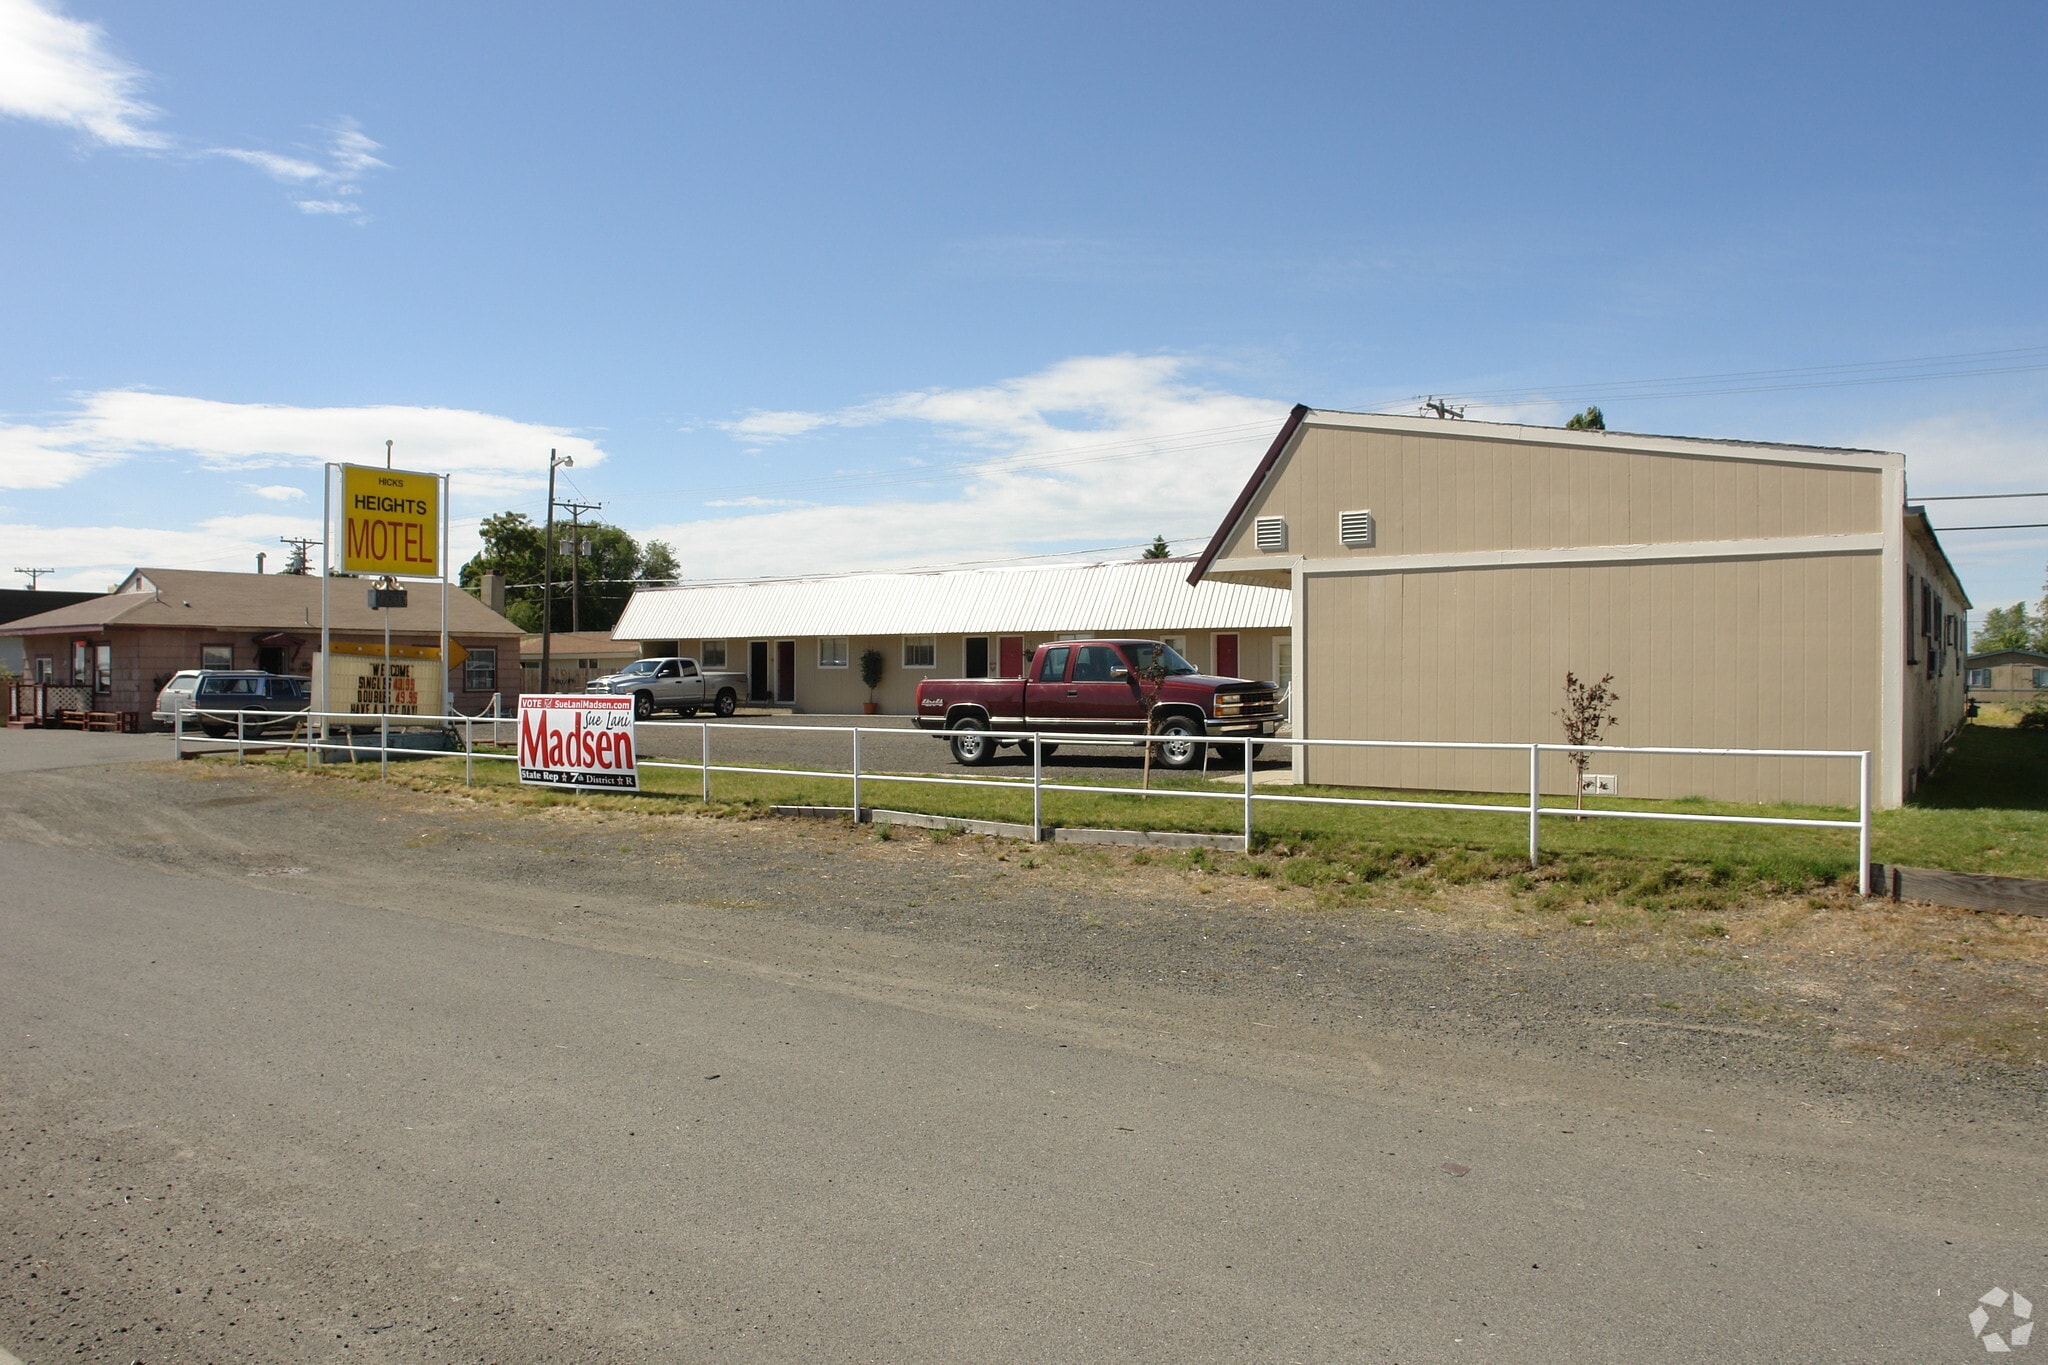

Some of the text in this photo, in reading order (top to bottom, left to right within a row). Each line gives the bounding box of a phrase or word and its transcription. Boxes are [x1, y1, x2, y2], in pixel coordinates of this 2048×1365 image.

[378, 477, 404, 488] HICKS
[354, 494, 427, 516] HEIGHTS
[347, 517, 433, 563] MOTEL
[357, 690, 391, 704] DOUBLES
[522, 699, 630, 709] VOTE SueLaniMadsen.com
[382, 704, 400, 714] NCE
[583, 711, 631, 730] Sue Lani
[520, 709, 634, 769] Madsen
[521, 770, 541, 780] State
[543, 771, 559, 782] Rep
[586, 775, 615, 785] District
[626, 776, 633, 785] R
